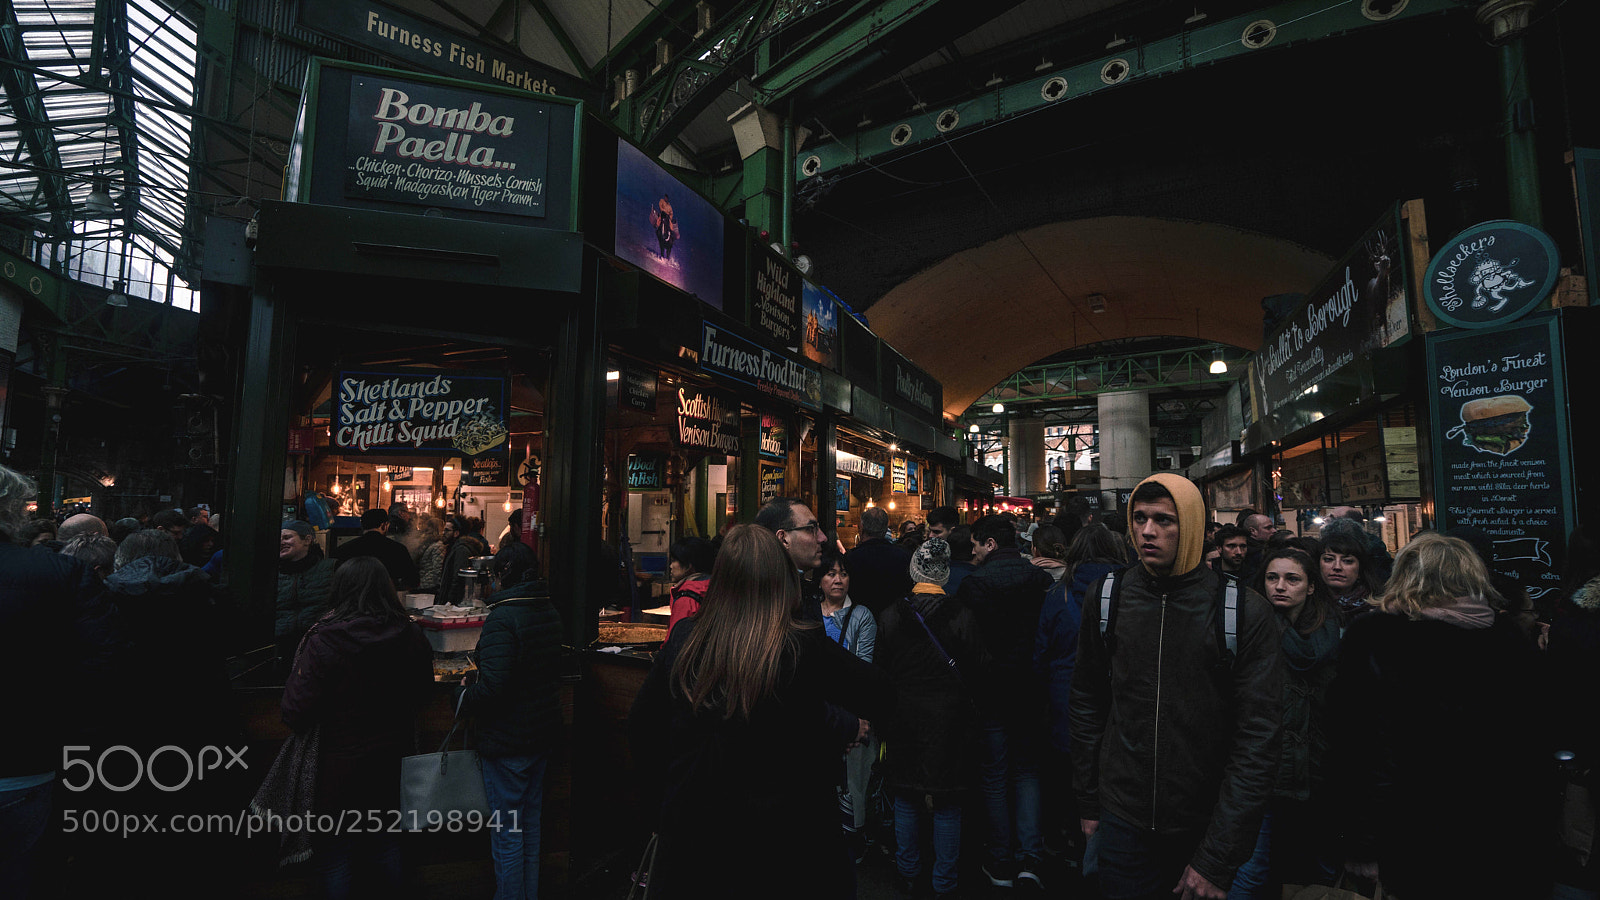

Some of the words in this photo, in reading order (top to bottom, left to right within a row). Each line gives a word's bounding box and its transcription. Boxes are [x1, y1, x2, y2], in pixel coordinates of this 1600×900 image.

[367, 10, 442, 57] Furness
[449, 42, 485, 75] Fish
[492, 59, 557, 96] Markets
[372, 87, 515, 138] Bomba
[372, 120, 517, 170] Paella...
[356, 172, 391, 191] Squid
[394, 176, 468, 200] Madagaskan
[470, 185, 500, 206] Tiger
[505, 175, 543, 195] Cornish
[766, 256, 789, 291] Wild
[1436, 235, 1496, 312] Shellseekers
[757, 271, 796, 315] Highland
[1292, 321, 1303, 351] to
[1305, 266, 1359, 343] Borough
[760, 311, 791, 341] Burgers
[702, 326, 760, 379] Furness
[759, 349, 789, 388] Food
[788, 359, 808, 393] Hut
[1439, 359, 1498, 382] London's
[1501, 352, 1547, 373] Finest
[340, 374, 453, 405] Shetlands
[677, 387, 711, 422] Scottish
[1440, 379, 1491, 398] Venison
[1494, 378, 1548, 395] Burger
[340, 401, 388, 424] Salt
[388, 398, 407, 422] &
[407, 396, 490, 422] Pepper
[335, 422, 396, 452] Chilli
[395, 416, 460, 449] Squid
[677, 415, 710, 447] Venison
[709, 422, 739, 454] Burgers
[1451, 461, 1469, 470] made
[1487, 459, 1498, 468] the
[1498, 458, 1519, 470] finest
[1520, 459, 1546, 467] venison
[1453, 472, 1470, 480] meat
[1472, 471, 1491, 480] which
[1498, 470, 1525, 479] sourced
[1525, 469, 1545, 481] from
[1478, 482, 1493, 491] wild
[1513, 482, 1528, 490] deer
[1529, 482, 1551, 490] herds
[1448, 506, 1465, 514] This
[1465, 506, 1495, 517] Gourmet
[1496, 506, 1525, 516] Burger
[1526, 506, 1532, 514] is
[1533, 506, 1557, 514] served
[1471, 517, 1488, 527] fresh
[1489, 517, 1509, 525] salad
[1525, 517, 1549, 526] choice
